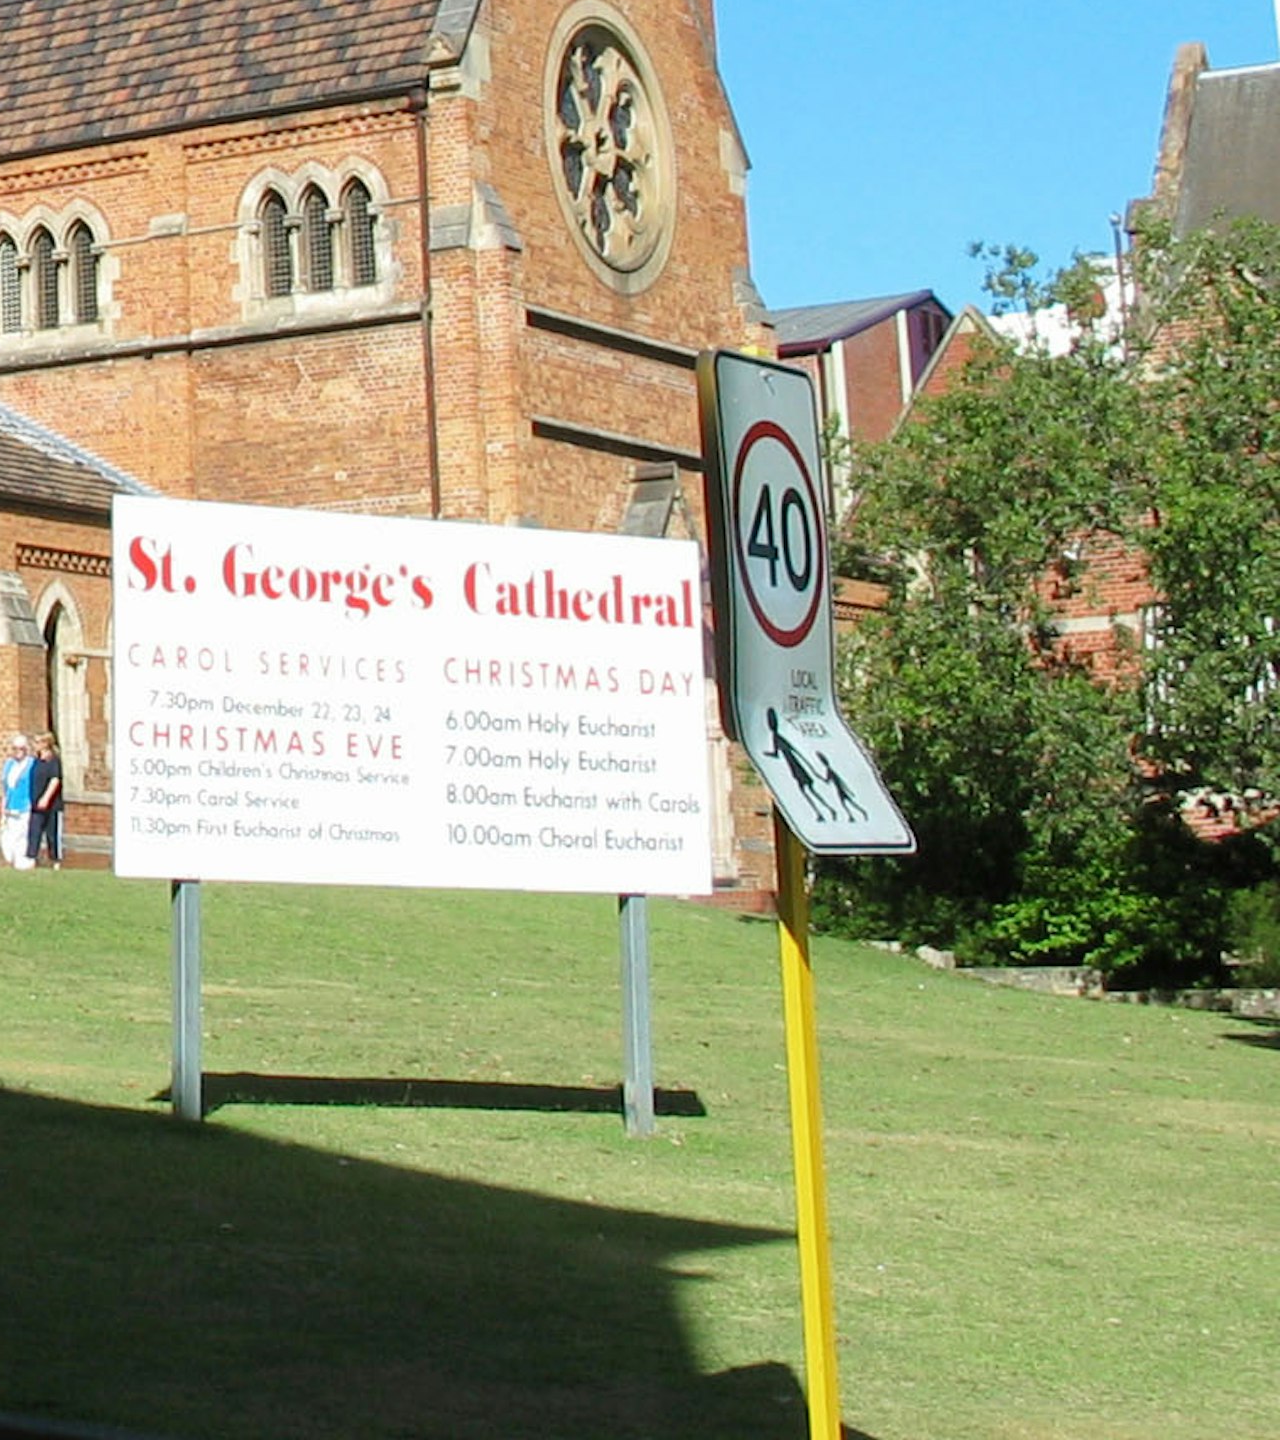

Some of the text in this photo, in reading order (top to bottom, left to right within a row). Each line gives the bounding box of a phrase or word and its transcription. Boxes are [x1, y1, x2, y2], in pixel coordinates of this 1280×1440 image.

[748, 483, 811, 592] 40
[128, 535, 695, 629] St. George's Cathedral
[128, 643, 406, 683] CAROL SERVICES
[443, 657, 694, 696] CHRISTMAS DAY
[149, 689, 392, 724] 7.30pm December 22, 23, 24
[446, 710, 656, 738] 6.00am Holy Eucharist
[129, 721, 402, 759] CHRISTMAS EVE
[130, 759, 410, 786] 5.00pm Children's Christmas Service
[446, 745, 657, 774] 7.00am Holy Eucharist
[130, 787, 300, 809] 7.30pm Carol Service
[446, 783, 701, 814] 8.00am Eucharist with Carols
[130, 817, 401, 843] 11.30pm First Eucharist of Christmas
[447, 823, 684, 852] 10.00am Choral Eucharist
